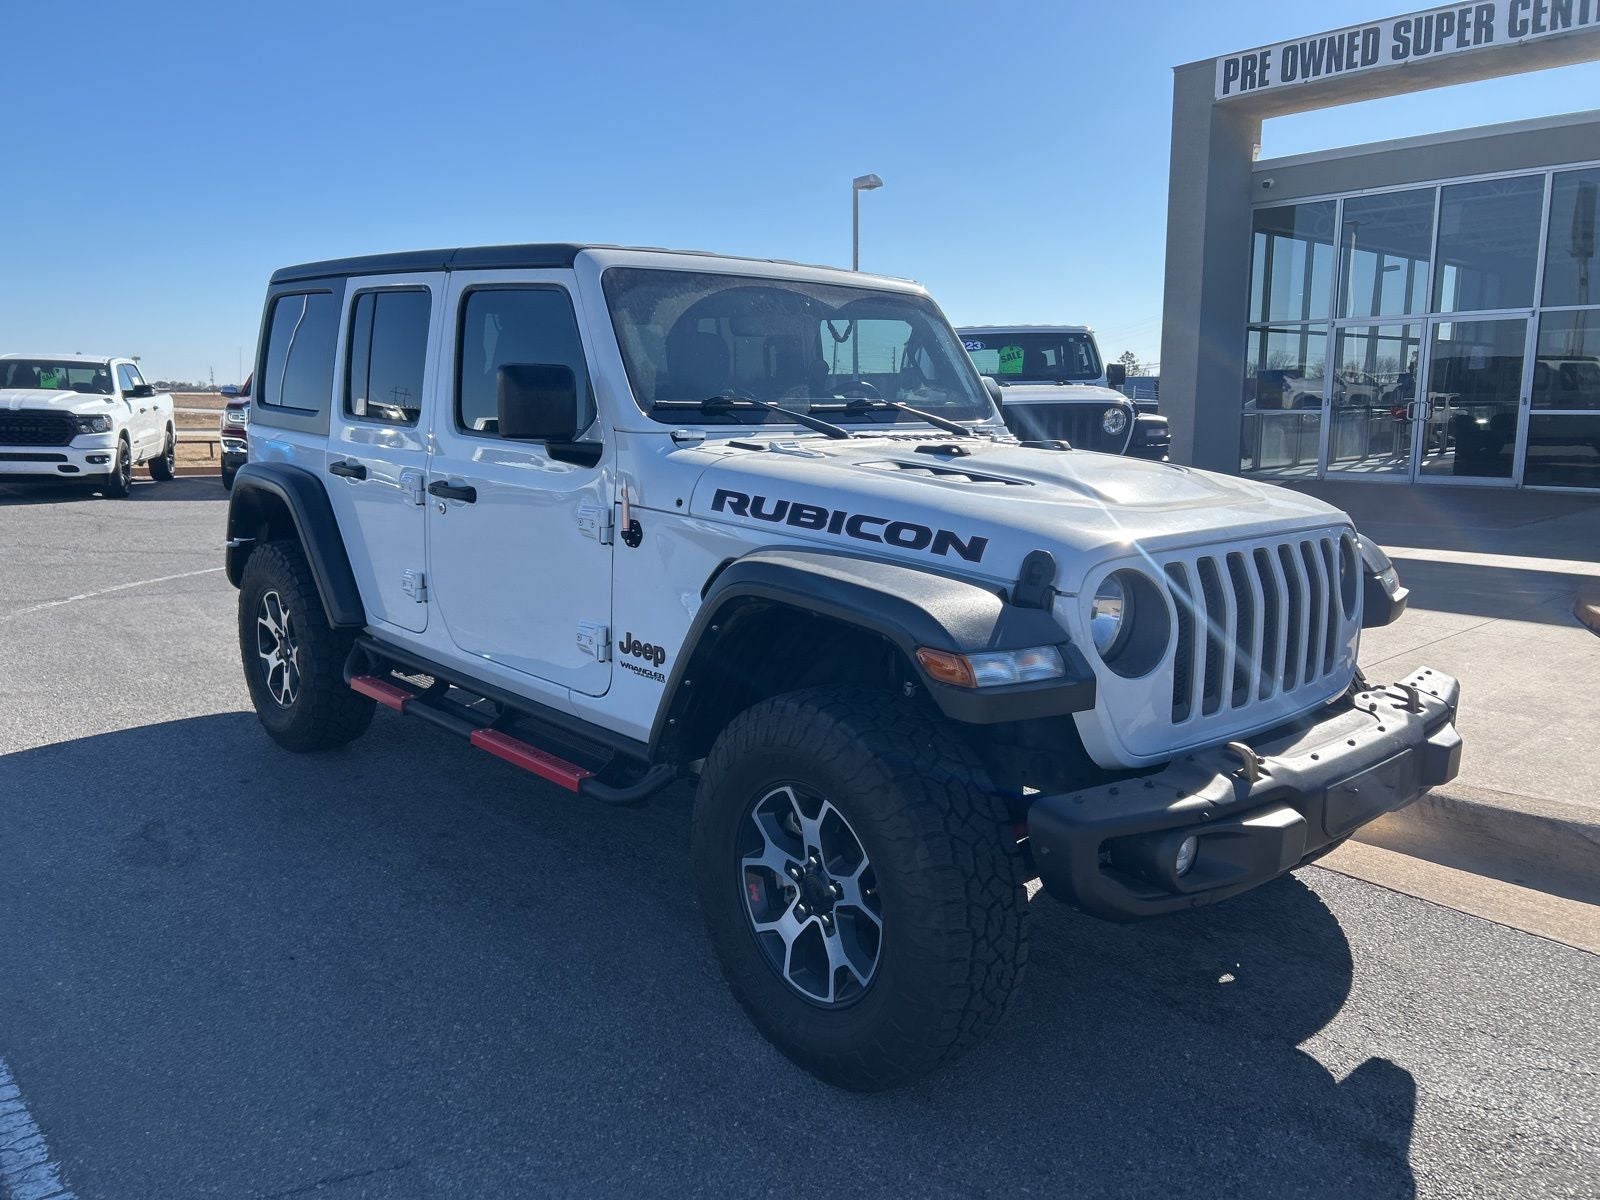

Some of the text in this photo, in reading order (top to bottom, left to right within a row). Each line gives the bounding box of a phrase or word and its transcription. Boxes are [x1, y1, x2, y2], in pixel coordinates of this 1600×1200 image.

[1222, 0, 1600, 95] PRE OWNED SUPER CENT
[1000, 351, 1022, 363] SALE
[711, 488, 989, 563] RUBICON
[619, 632, 665, 667] Jeep
[620, 660, 665, 680] WRANGLER
